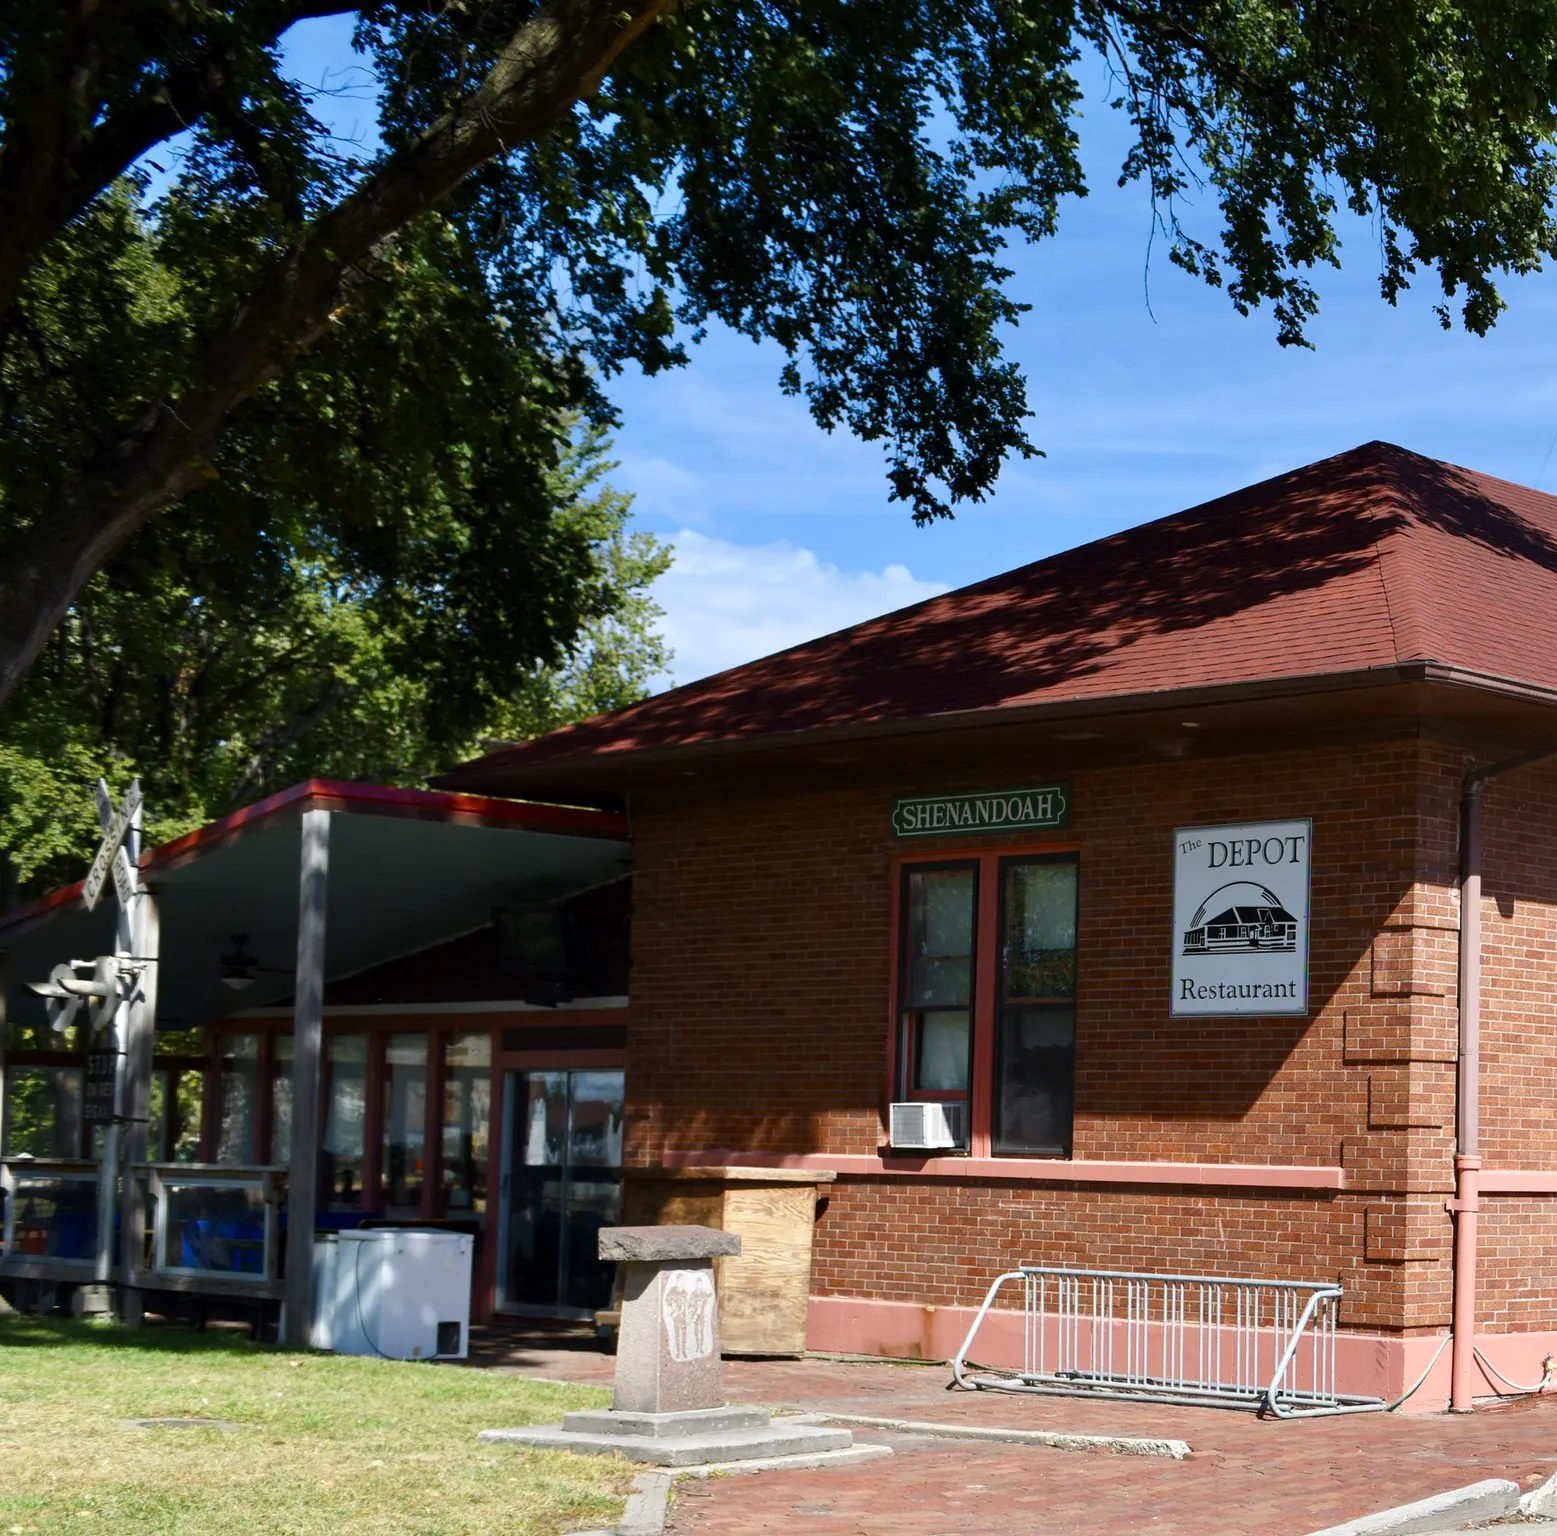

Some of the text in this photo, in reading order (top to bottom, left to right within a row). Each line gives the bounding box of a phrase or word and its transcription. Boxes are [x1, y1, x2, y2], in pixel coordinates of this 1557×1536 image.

[902, 794, 1053, 829] SHENANDOAH
[1178, 836, 1305, 868] The DEPOT
[115, 855, 131, 904] ROAD
[1179, 978, 1297, 1000] Restaurant
